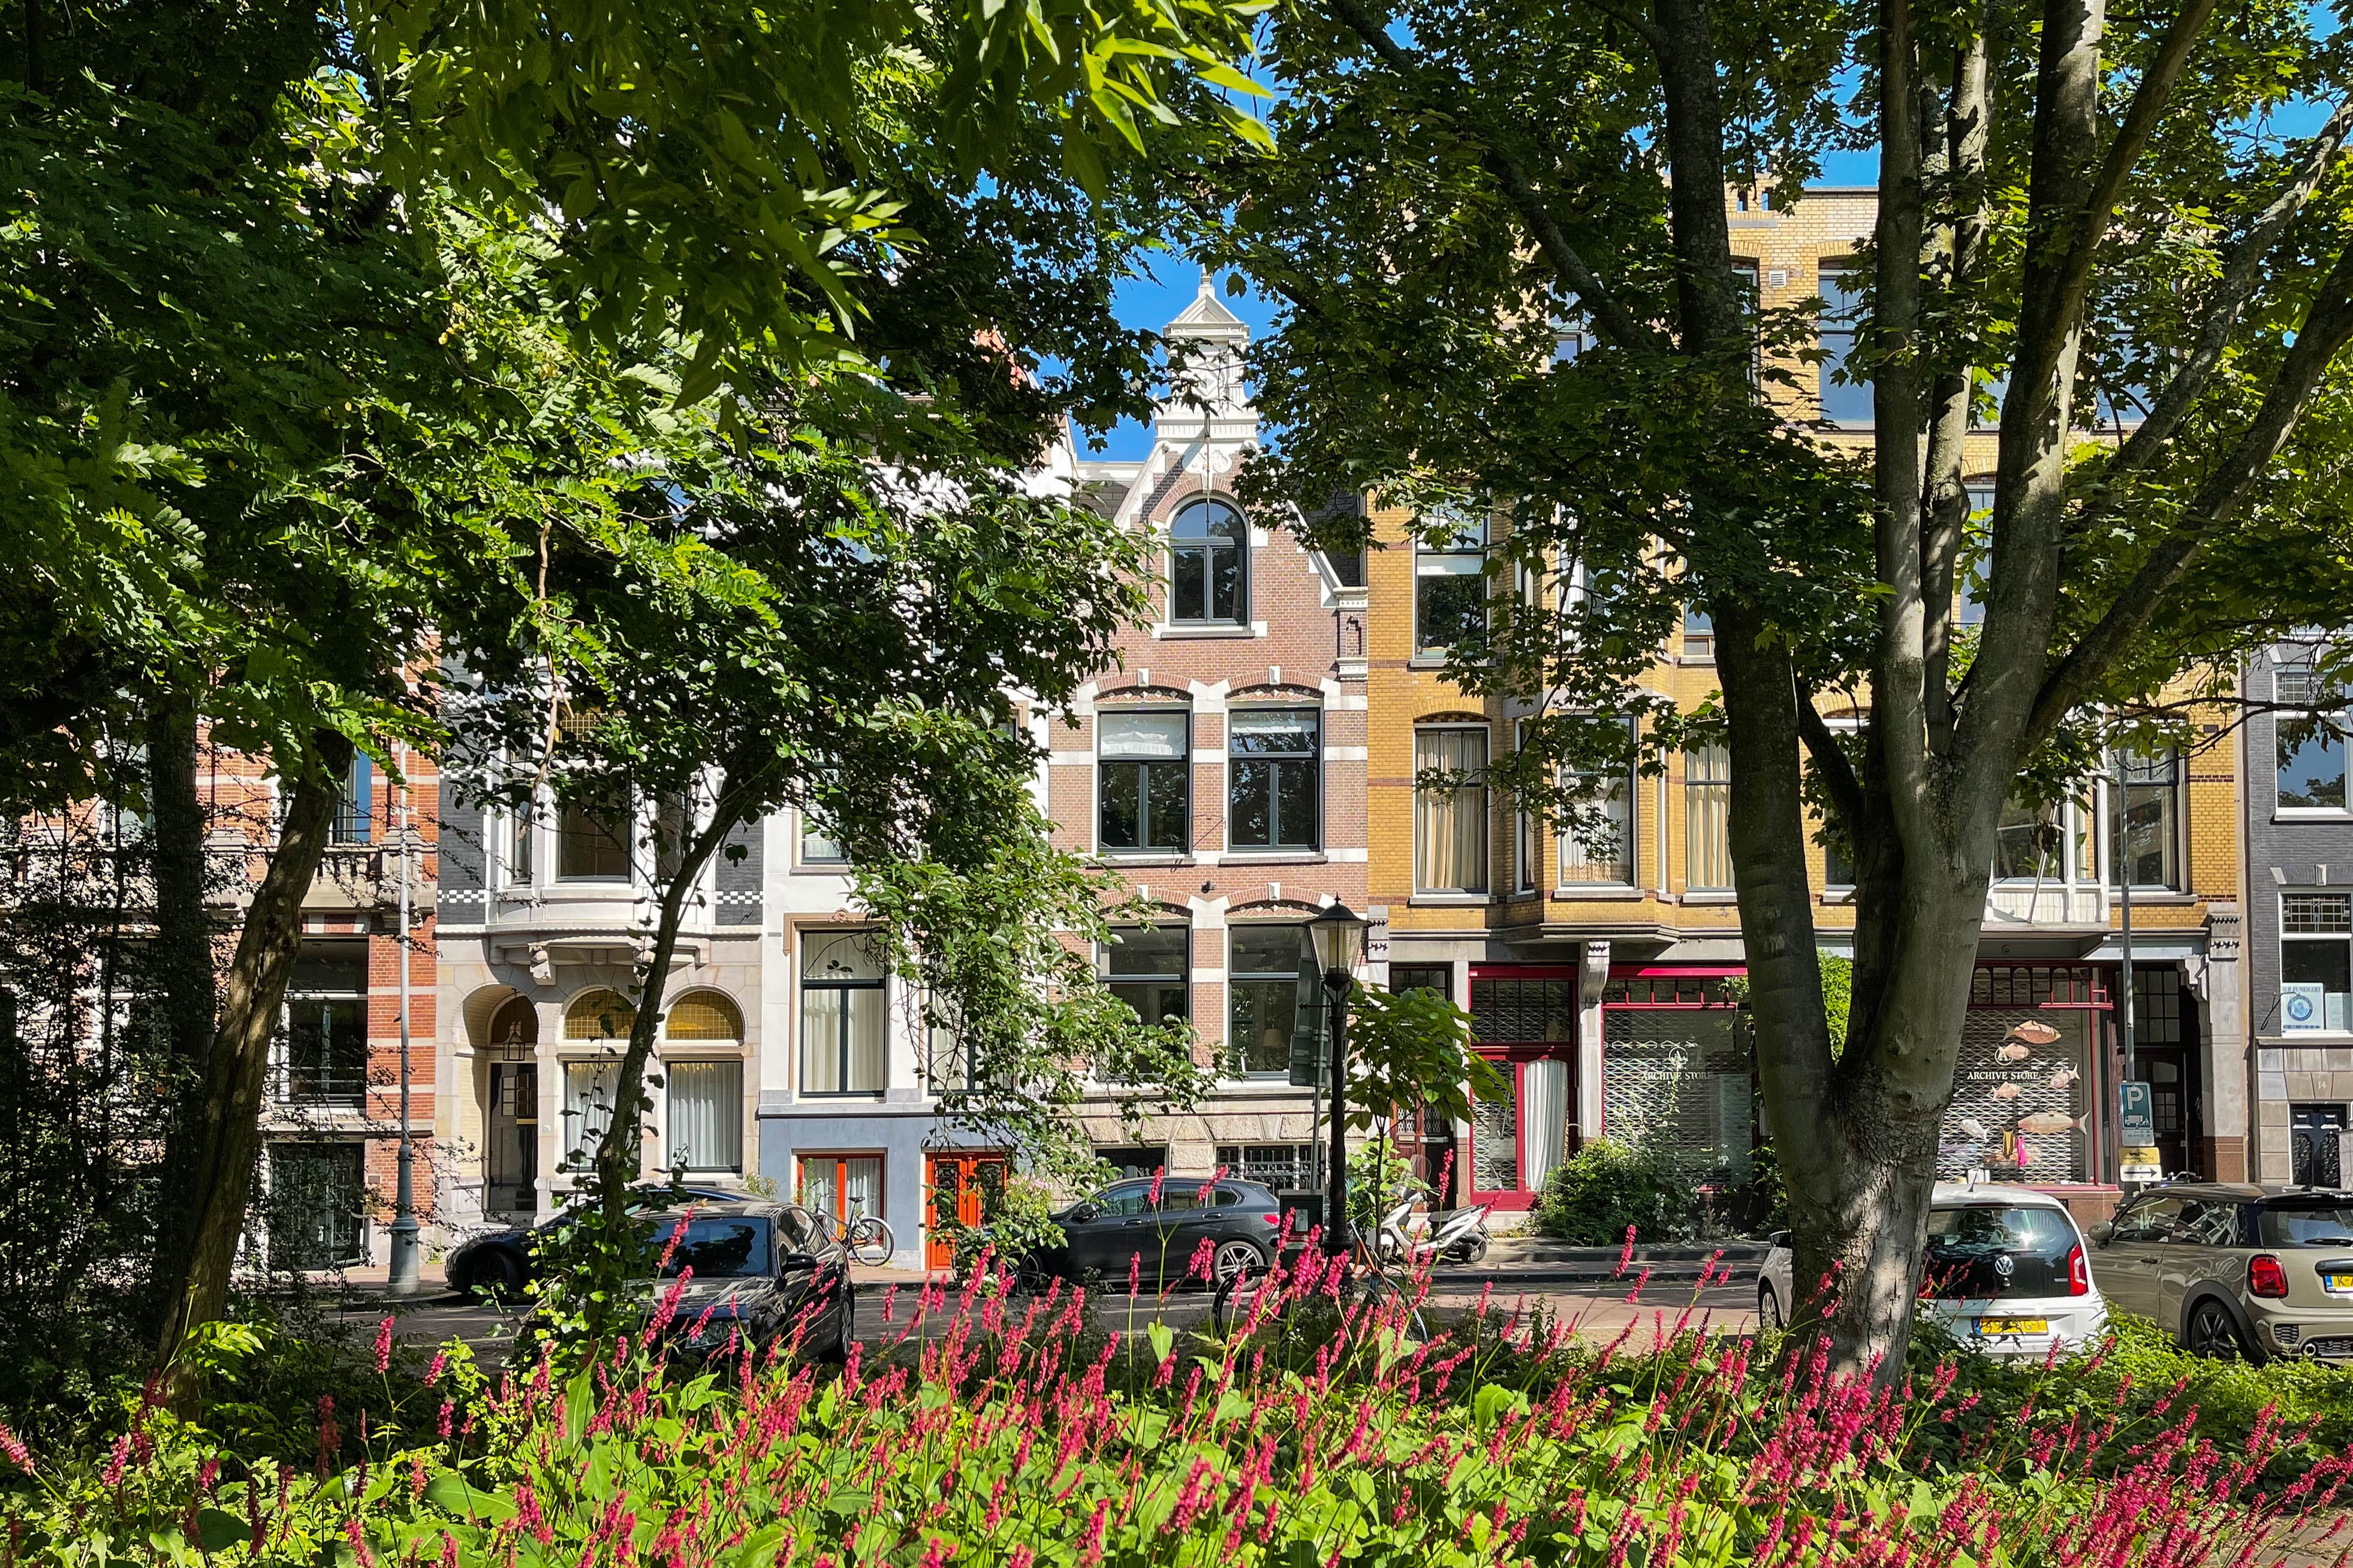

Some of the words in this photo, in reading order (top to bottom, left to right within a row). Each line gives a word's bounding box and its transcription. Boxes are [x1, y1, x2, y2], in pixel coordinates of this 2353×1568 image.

[1642, 1072, 1682, 1080] ARCHIVE
[2011, 1071, 2039, 1079] STORE
[2126, 1086, 2143, 1110] P
